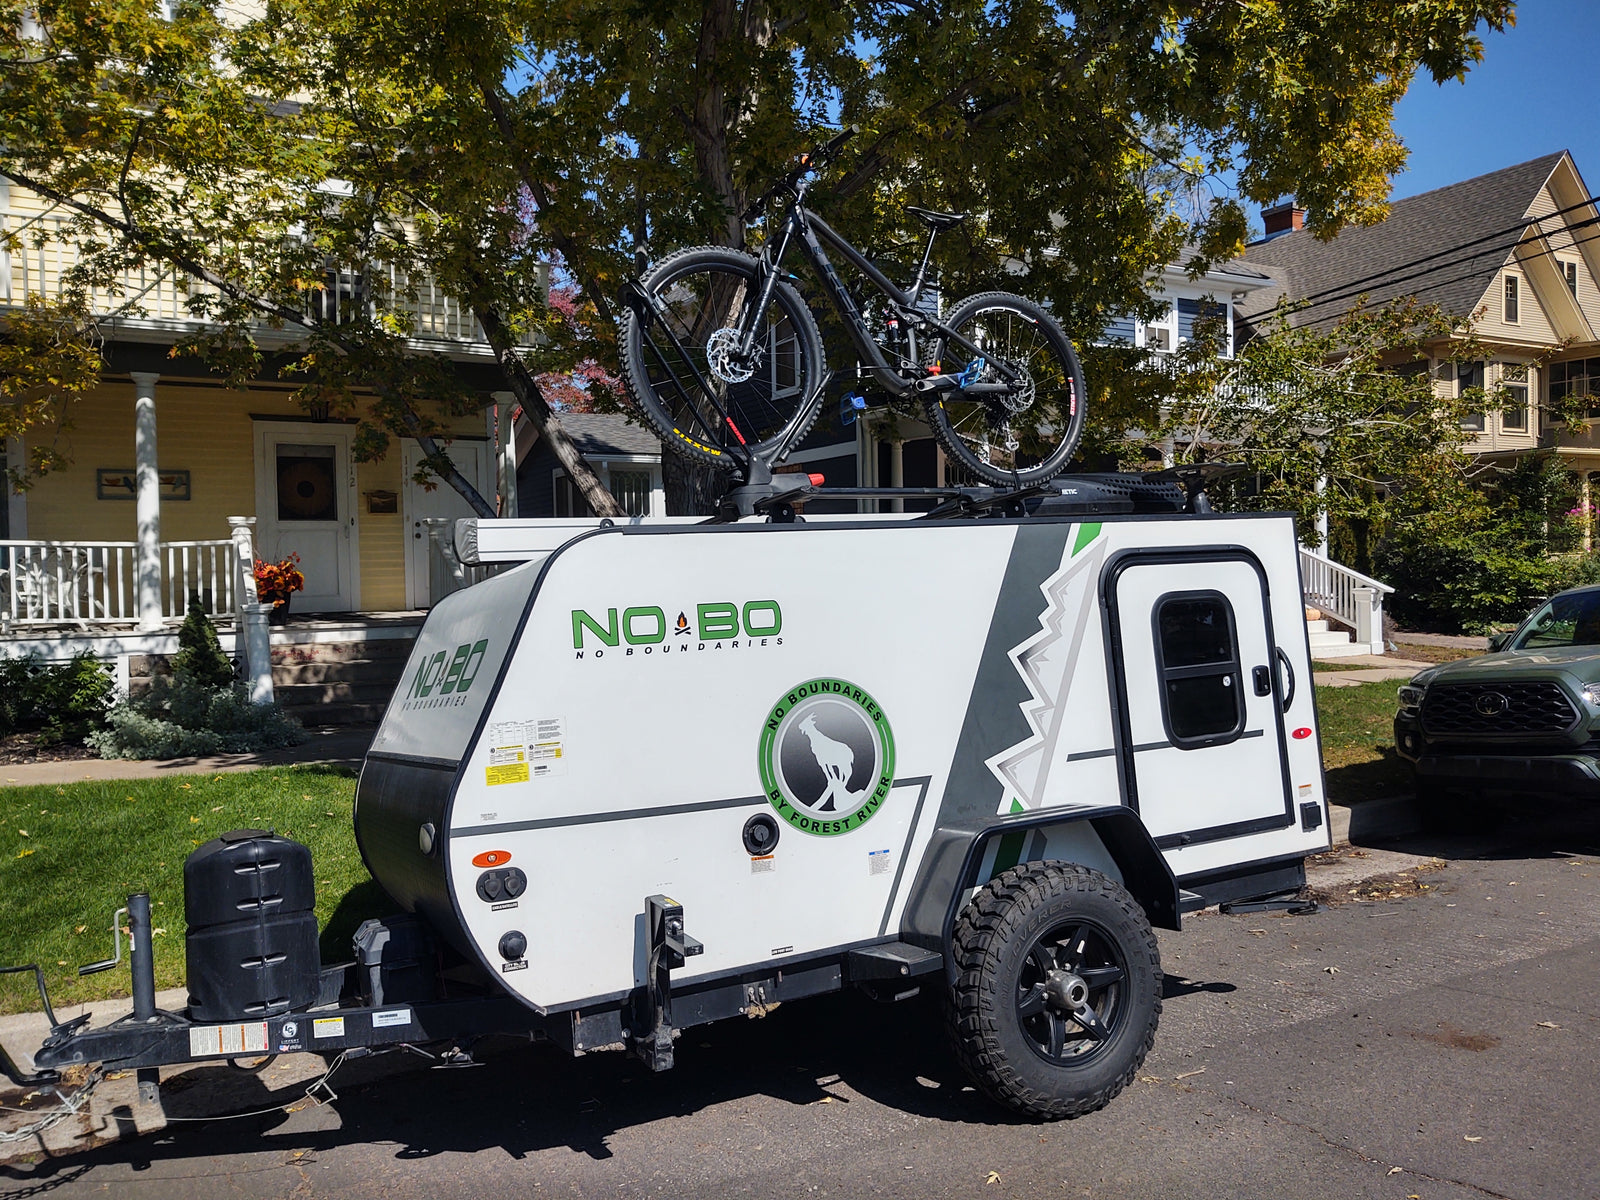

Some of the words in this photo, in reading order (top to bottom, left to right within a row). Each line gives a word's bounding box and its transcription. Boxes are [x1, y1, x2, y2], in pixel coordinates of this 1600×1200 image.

[673, 428, 721, 456] MAXXIS
[575, 650, 604, 660] NO
[626, 637, 784, 656] BOUNDARIES
[768, 707, 785, 731] NO
[787, 681, 882, 723] BOUNDARIES
[770, 788, 788, 811] BY
[790, 811, 850, 833] FOREST
[856, 776, 890, 822] RIVER
